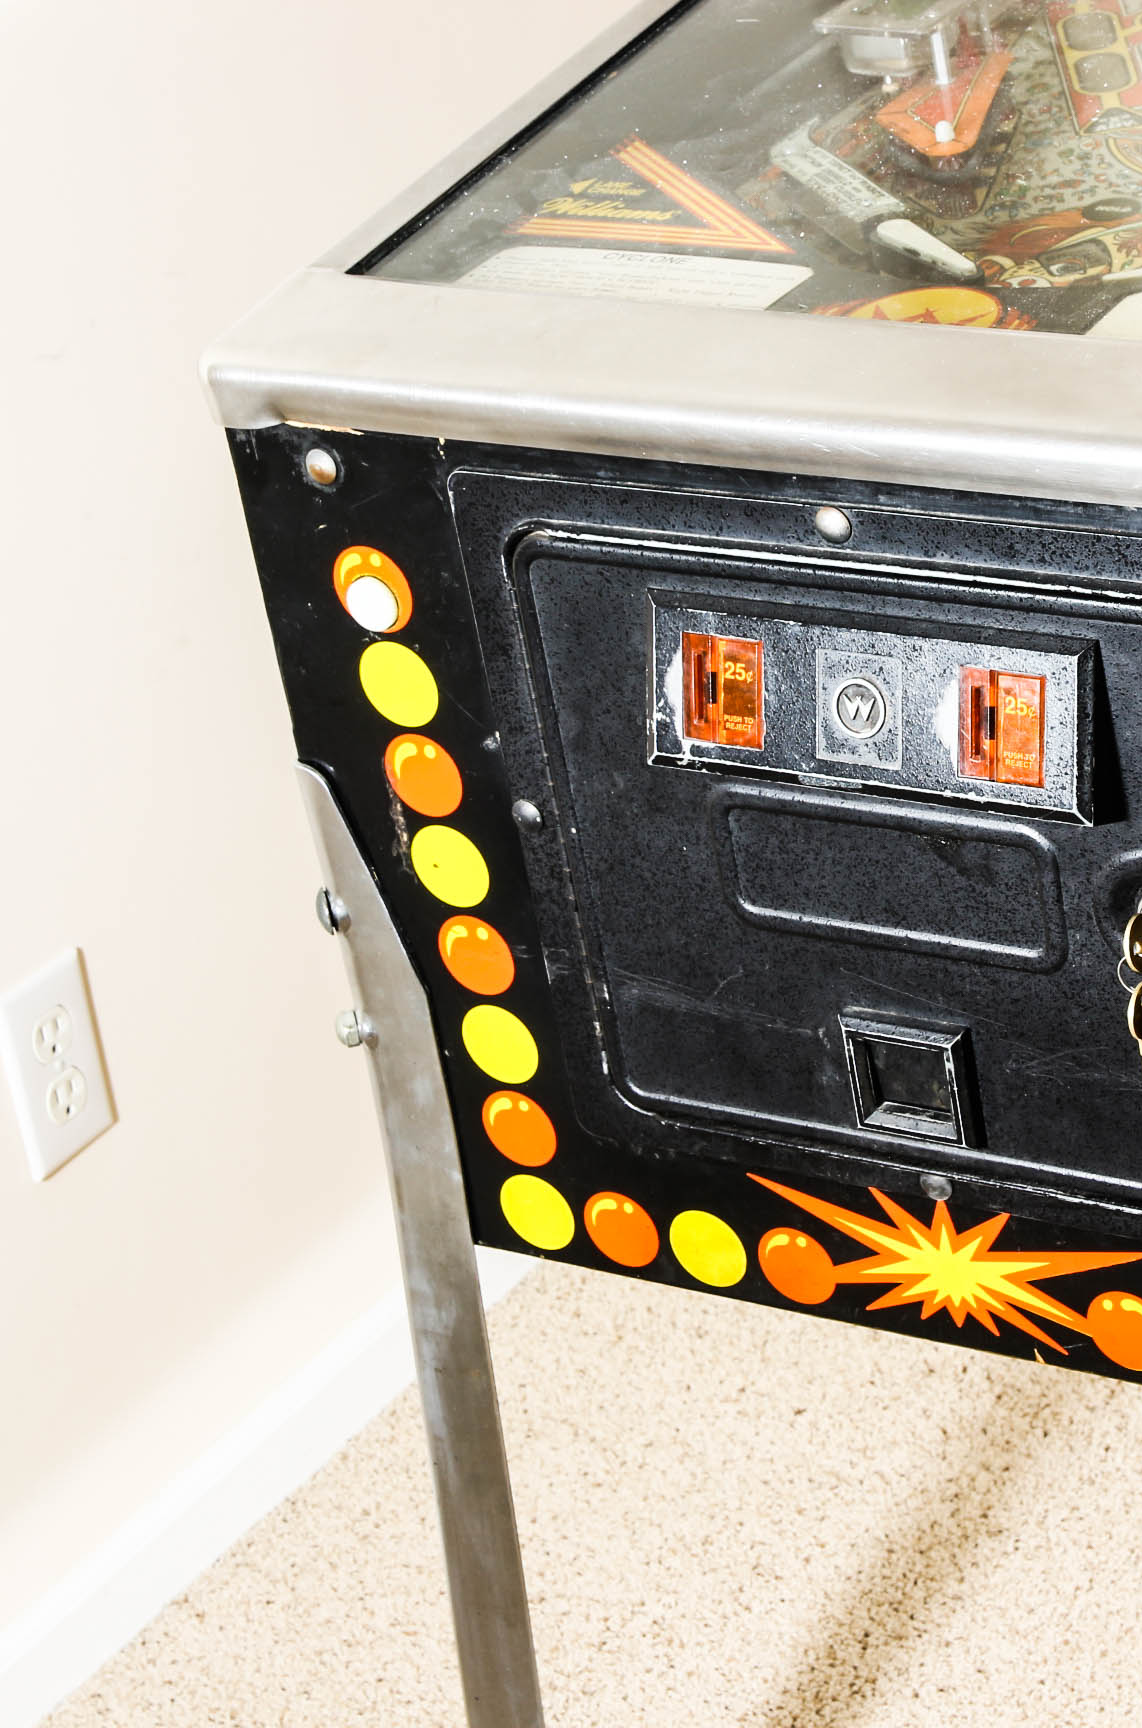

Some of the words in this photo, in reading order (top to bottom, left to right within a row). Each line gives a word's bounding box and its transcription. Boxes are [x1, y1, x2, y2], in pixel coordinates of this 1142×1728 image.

[538, 196, 682, 221] Williams
[602, 252, 688, 265] CYCLONE
[723, 660, 754, 684] 25¢
[1004, 695, 1037, 719] 25¢
[723, 713, 742, 725] PUSH
[743, 716, 754, 726] TO
[725, 720, 753, 733] REJECT
[1003, 751, 1023, 761] PUSH
[1024, 753, 1037, 763] TO
[1004, 759, 1034, 770] REJECT
